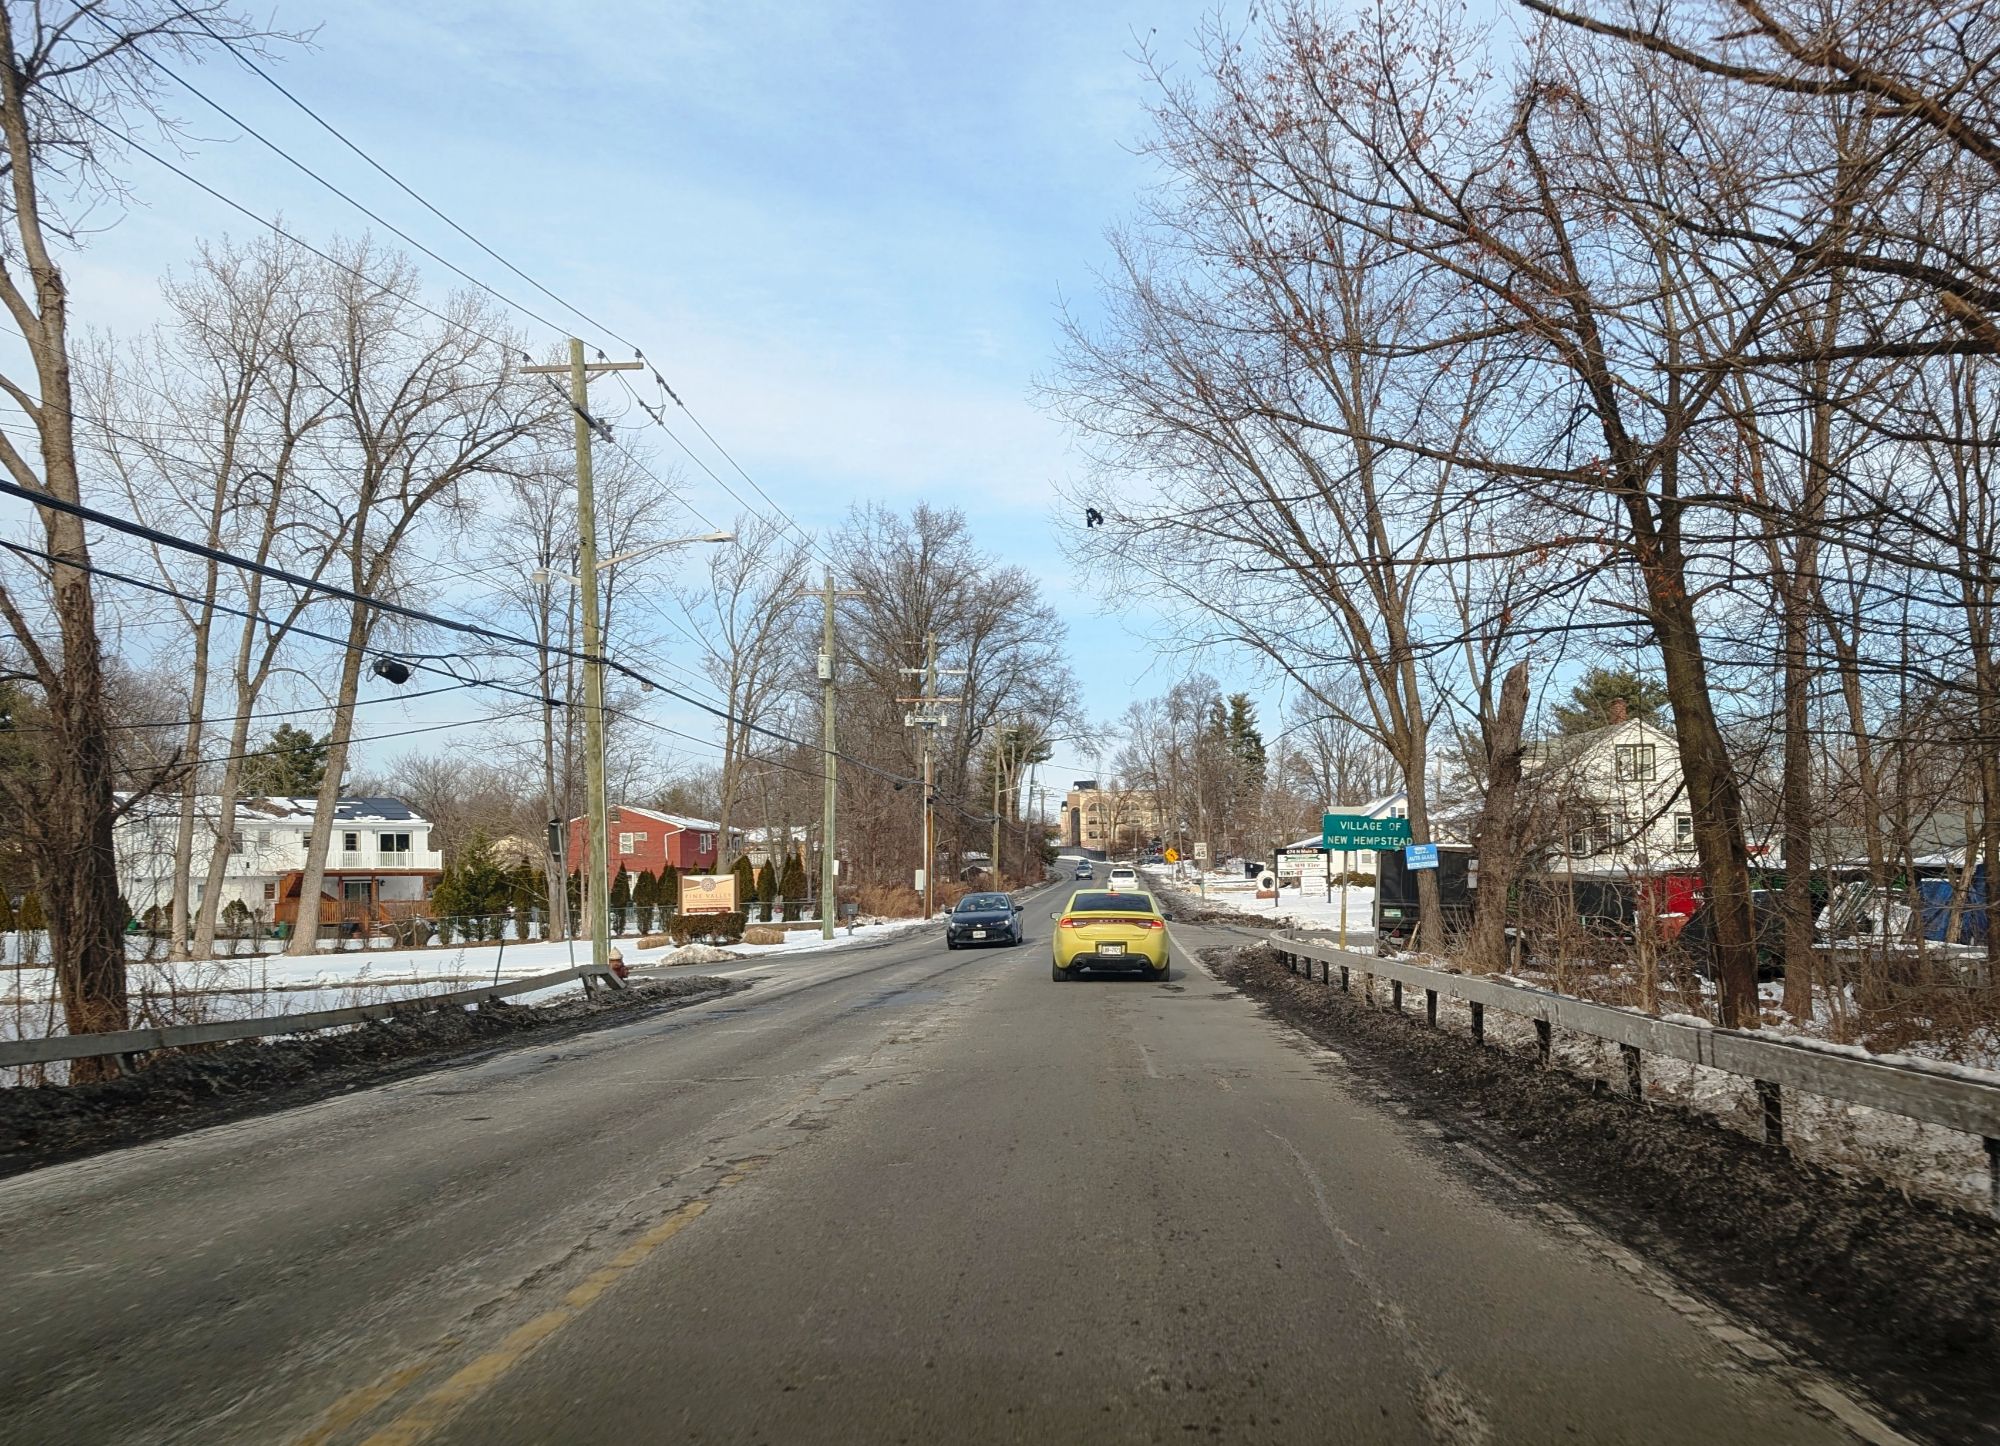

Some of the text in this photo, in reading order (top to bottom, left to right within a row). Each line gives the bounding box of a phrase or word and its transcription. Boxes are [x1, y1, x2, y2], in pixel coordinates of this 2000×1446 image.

[1340, 821, 1402, 831] VILLAGE OF
[1327, 835, 1413, 846] NEW HEMPSTEAD
